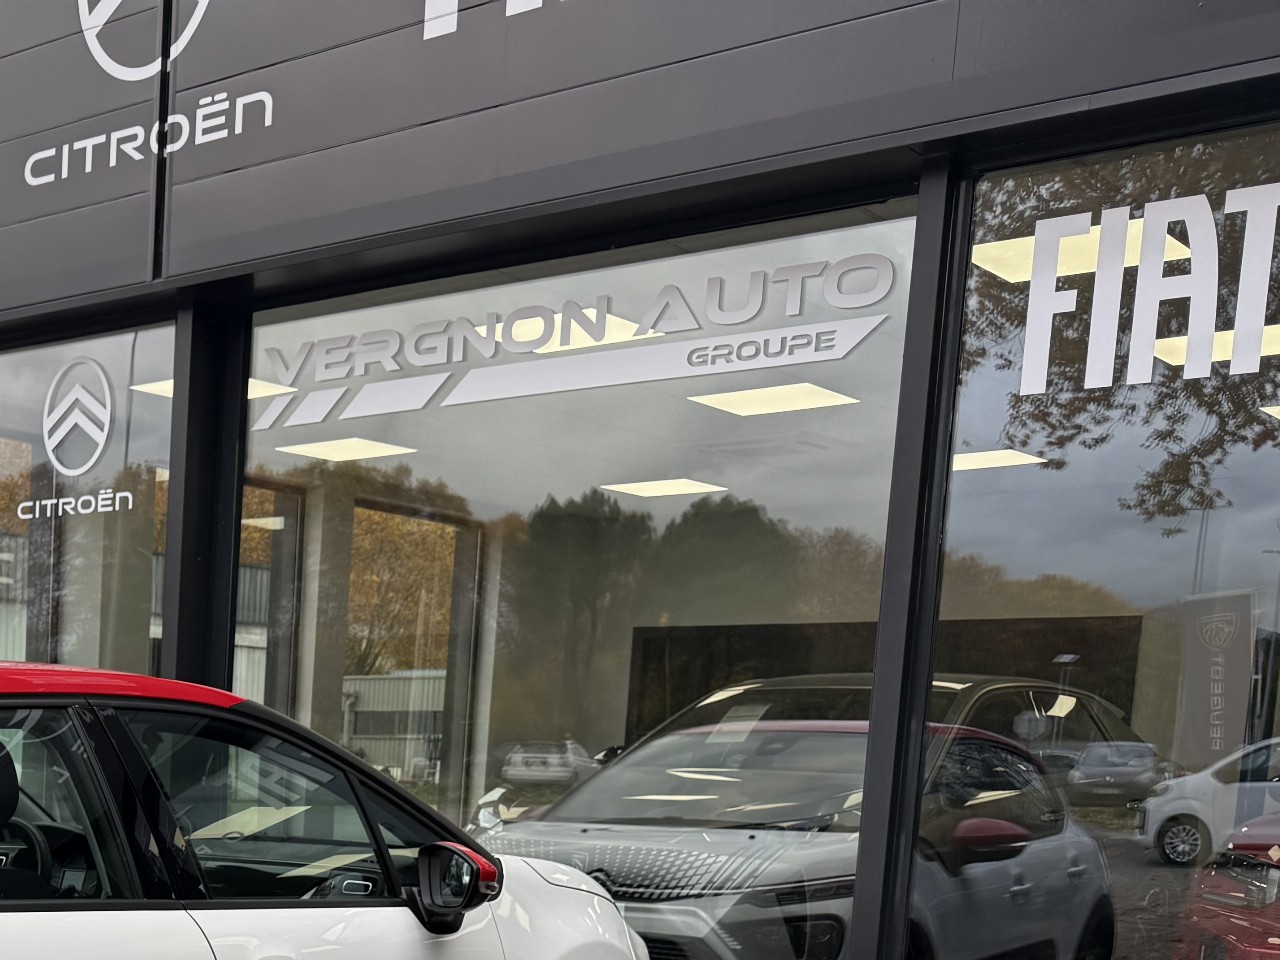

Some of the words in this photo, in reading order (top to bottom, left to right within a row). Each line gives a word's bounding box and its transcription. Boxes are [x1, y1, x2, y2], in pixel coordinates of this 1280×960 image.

[24, 91, 273, 187] CITROËN
[265, 294, 611, 386] VERGNON
[636, 253, 897, 337] AUTO
[1020, 182, 1280, 395] FIAT
[686, 329, 838, 367] GROUPE
[17, 489, 133, 520] CITROËN
